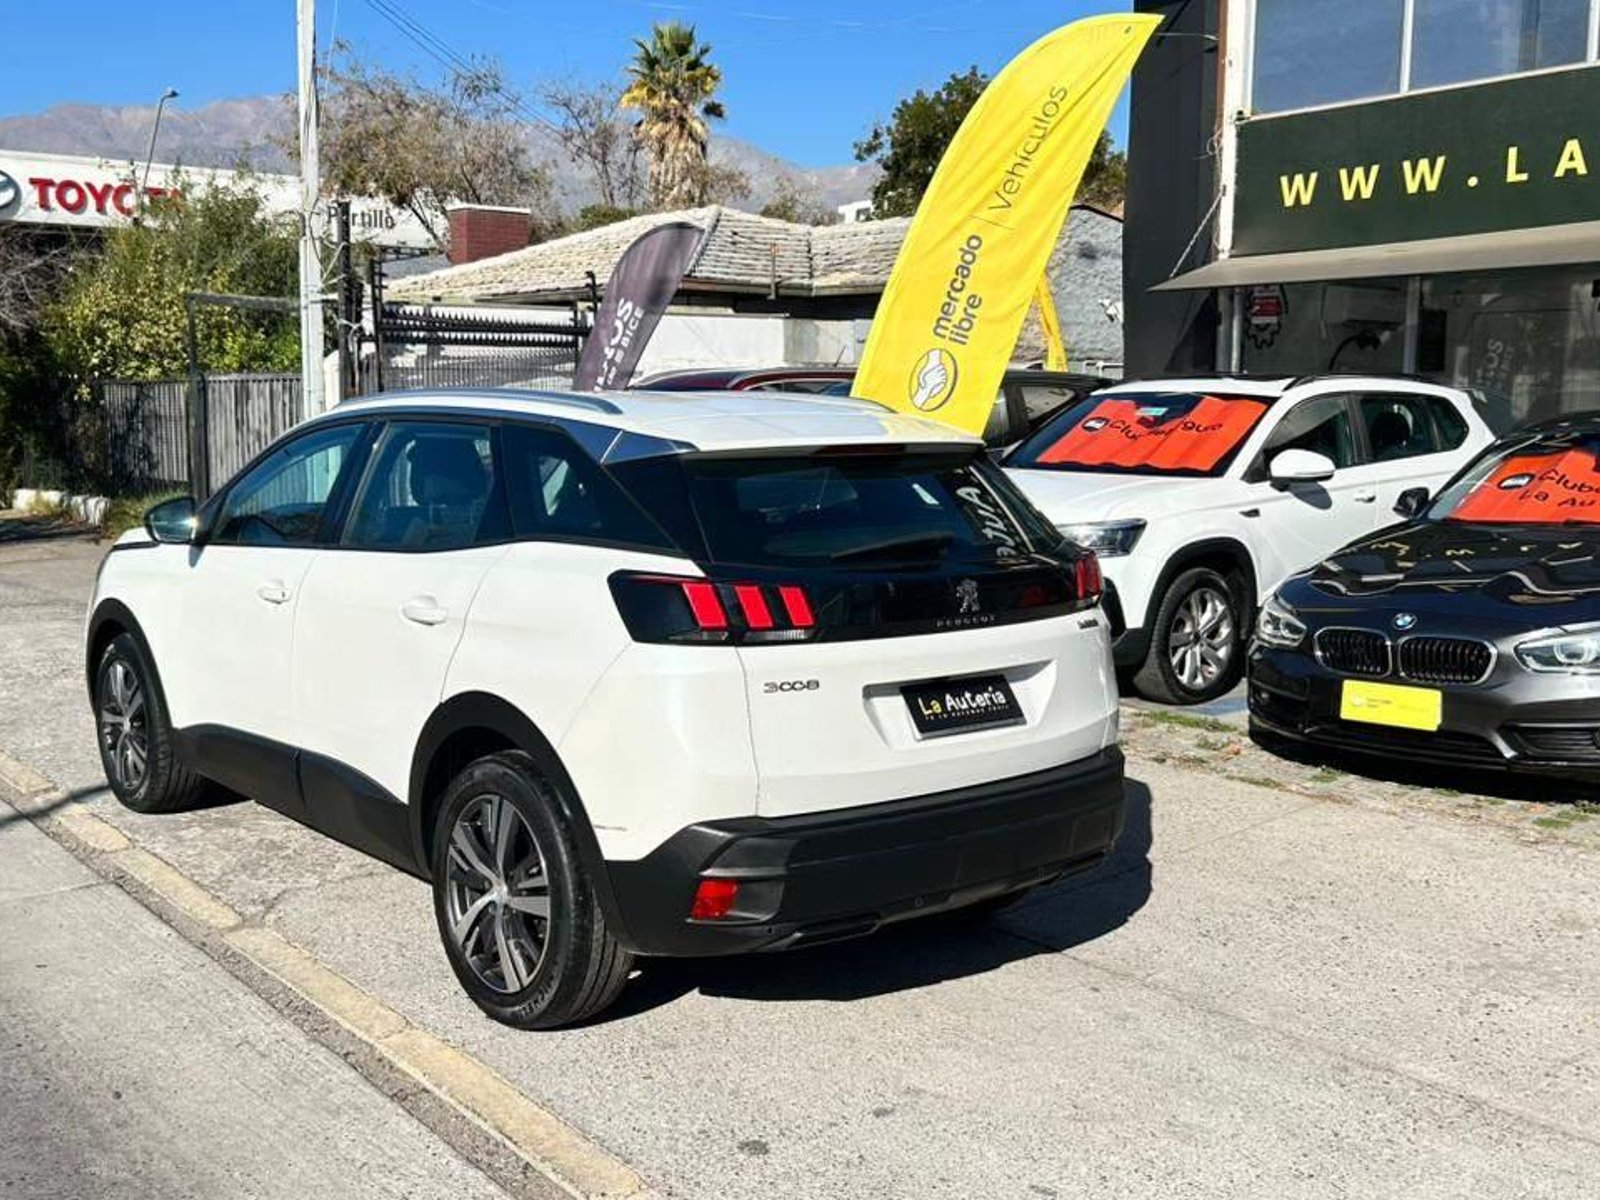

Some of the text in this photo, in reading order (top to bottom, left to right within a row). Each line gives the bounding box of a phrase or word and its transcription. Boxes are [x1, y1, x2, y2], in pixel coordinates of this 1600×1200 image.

[989, 85, 1068, 211] Vehículos
[327, 206, 396, 229] Prtillo
[933, 234, 982, 339] mercado
[948, 294, 982, 345] libre
[918, 697, 942, 716] La
